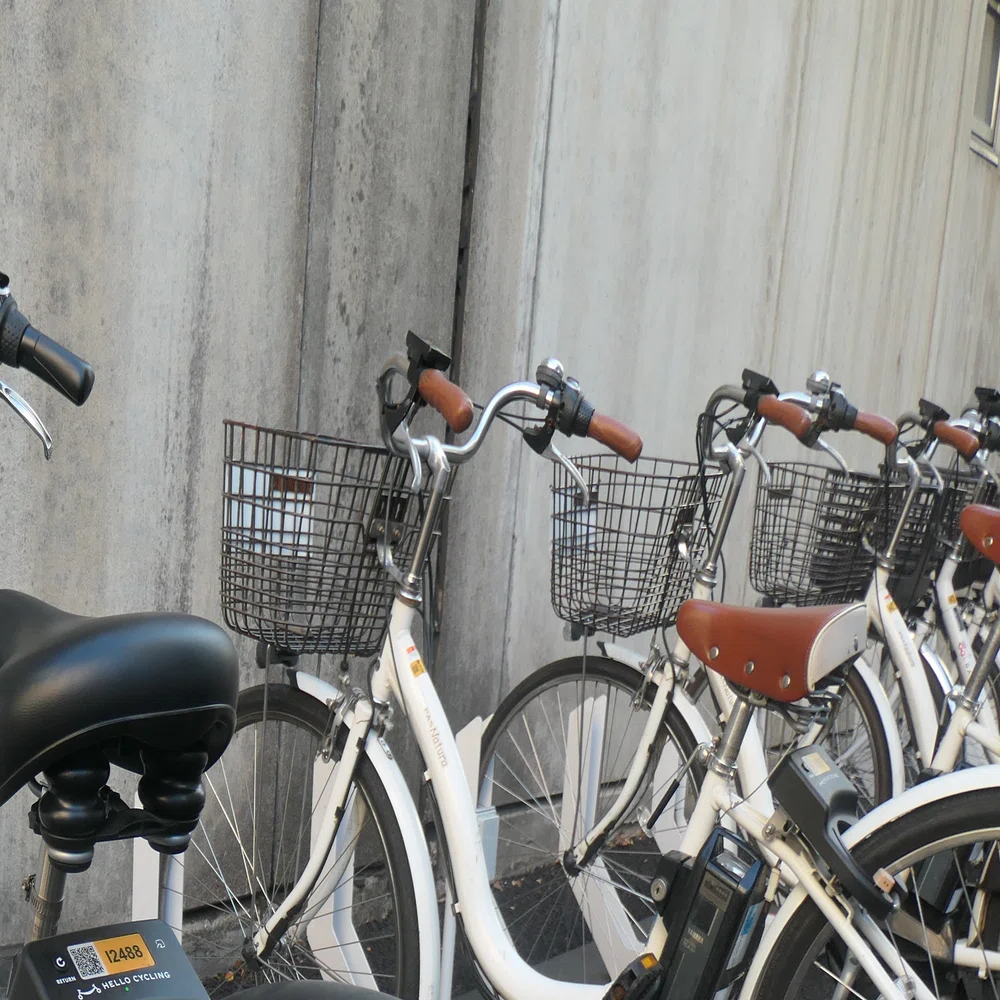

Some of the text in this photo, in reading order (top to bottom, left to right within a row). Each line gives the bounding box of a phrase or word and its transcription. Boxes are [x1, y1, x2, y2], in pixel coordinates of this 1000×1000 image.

[429, 727, 448, 768] Natura
[105, 944, 144, 964] 12488
[56, 976, 77, 985] RETURN
[101, 971, 171, 990] HELLO CYCLING
